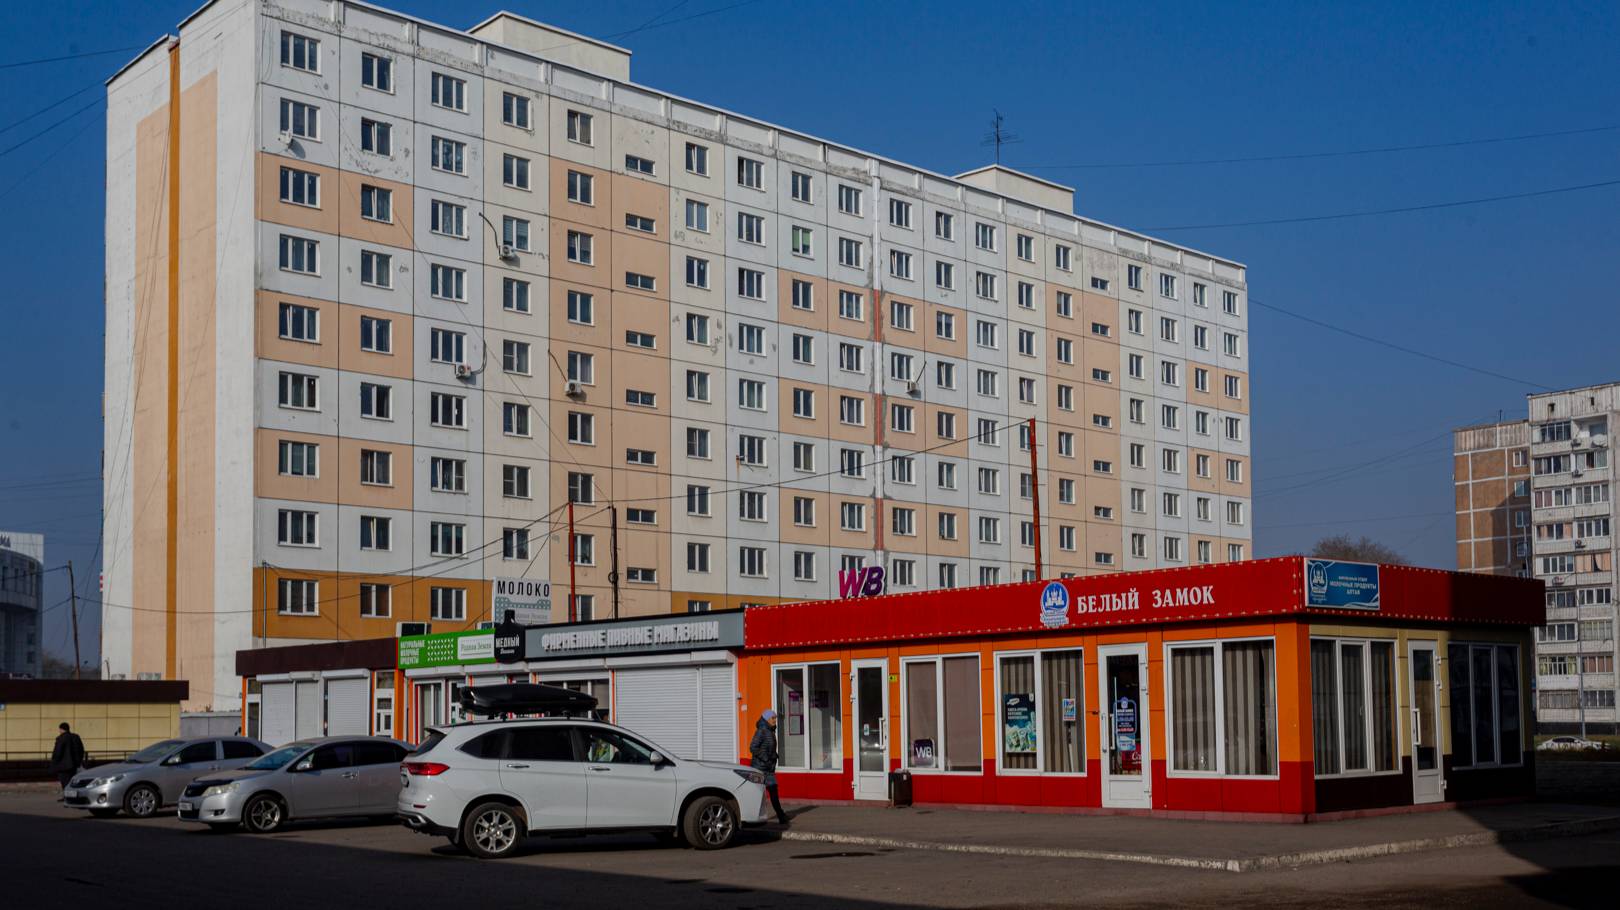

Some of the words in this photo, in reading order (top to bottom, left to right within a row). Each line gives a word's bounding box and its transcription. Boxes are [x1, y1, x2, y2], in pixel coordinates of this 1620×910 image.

[497, 580, 551, 598] МОЛОКО
[838, 566, 885, 599] WB
[1354, 582, 1376, 590] ПРОДУКТЫ
[1077, 588, 1140, 614] БЕЛЫЙ
[1152, 585, 1216, 609] ЗАМОК
[495, 634, 520, 648] МЕДНЫЙ
[915, 745, 932, 758] WB
